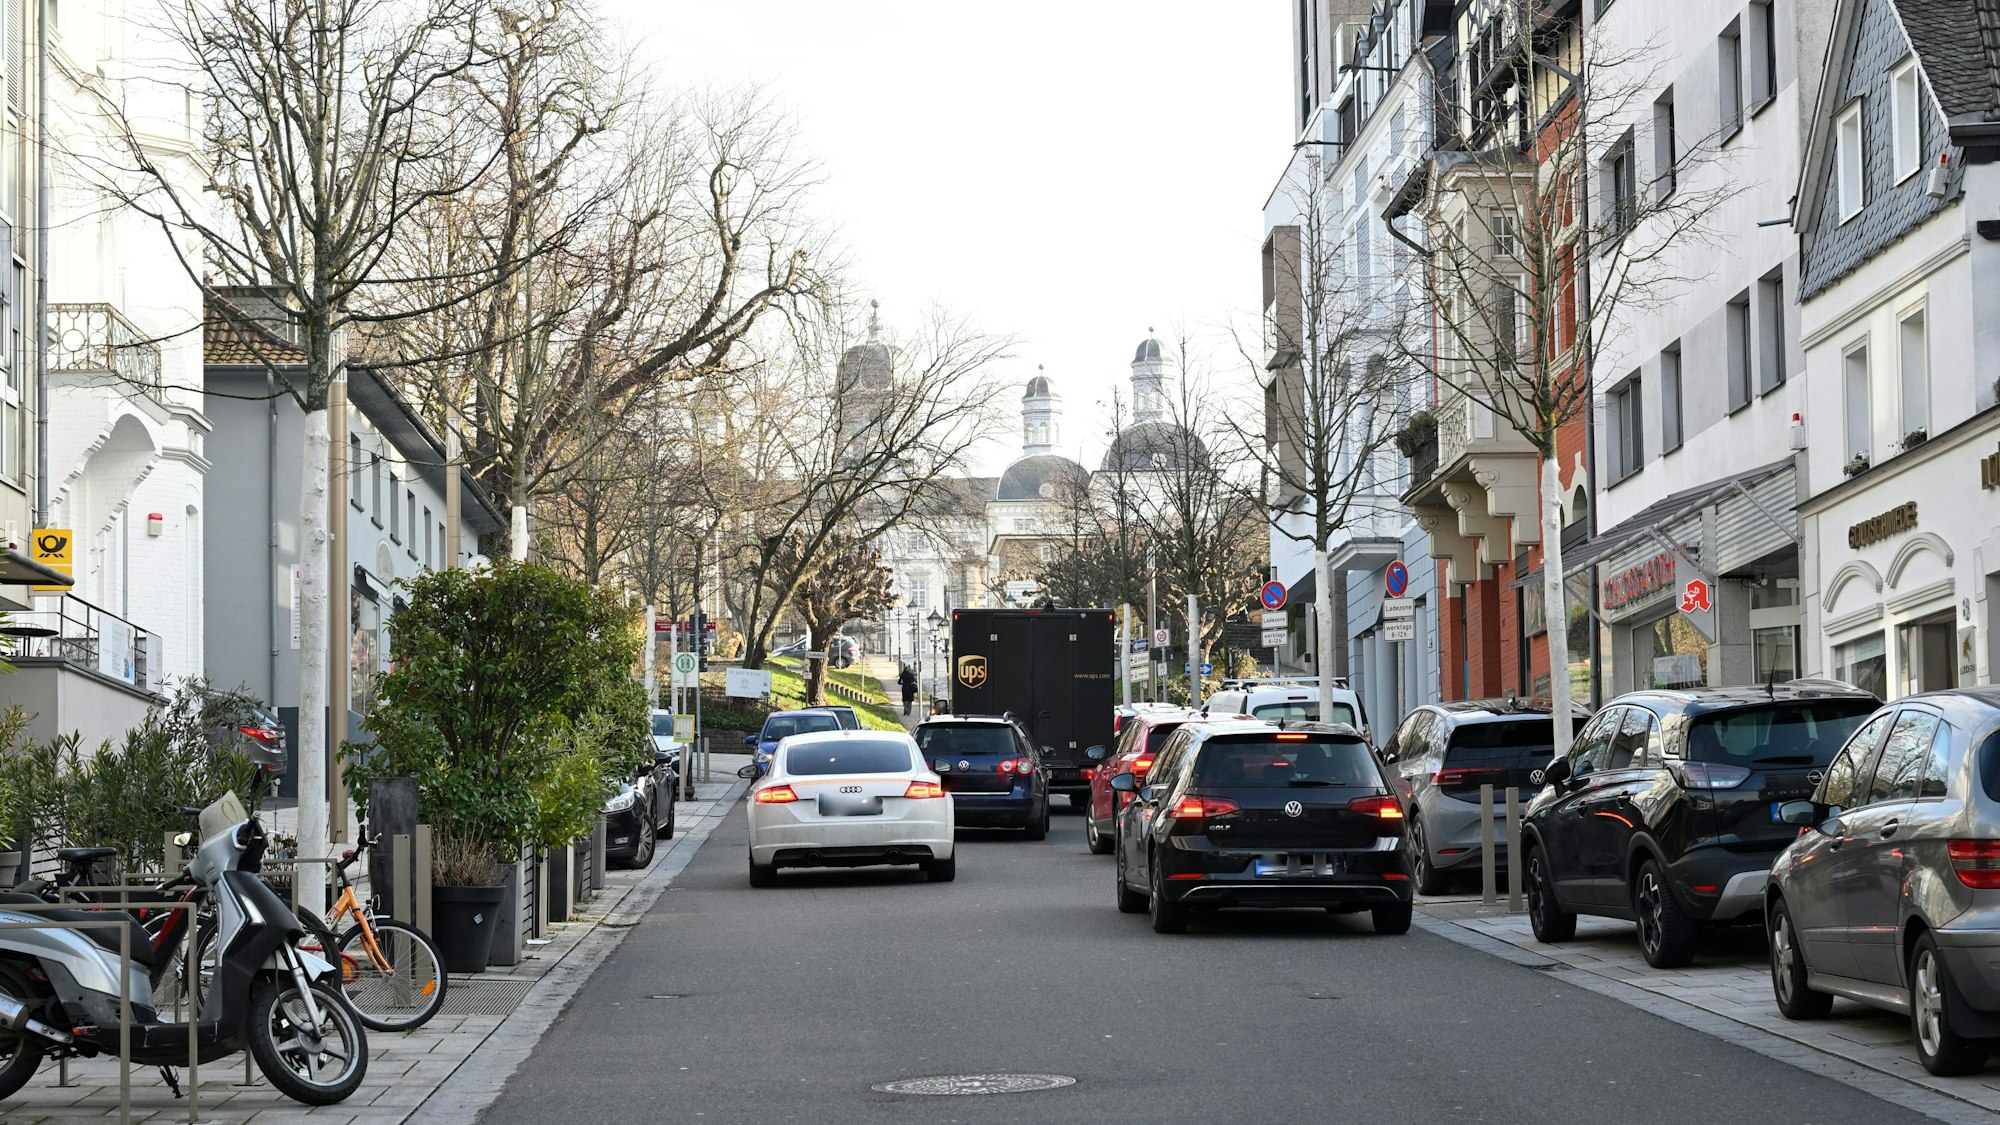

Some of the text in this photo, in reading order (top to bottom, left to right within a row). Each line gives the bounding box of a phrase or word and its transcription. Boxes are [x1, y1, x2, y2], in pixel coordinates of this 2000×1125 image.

[1604, 543, 1688, 610] SCHLOSS-APOTHE
[1386, 604, 1413, 612] Ladezone
[1386, 624, 1413, 632] werktags
[960, 665, 985, 684] ups
